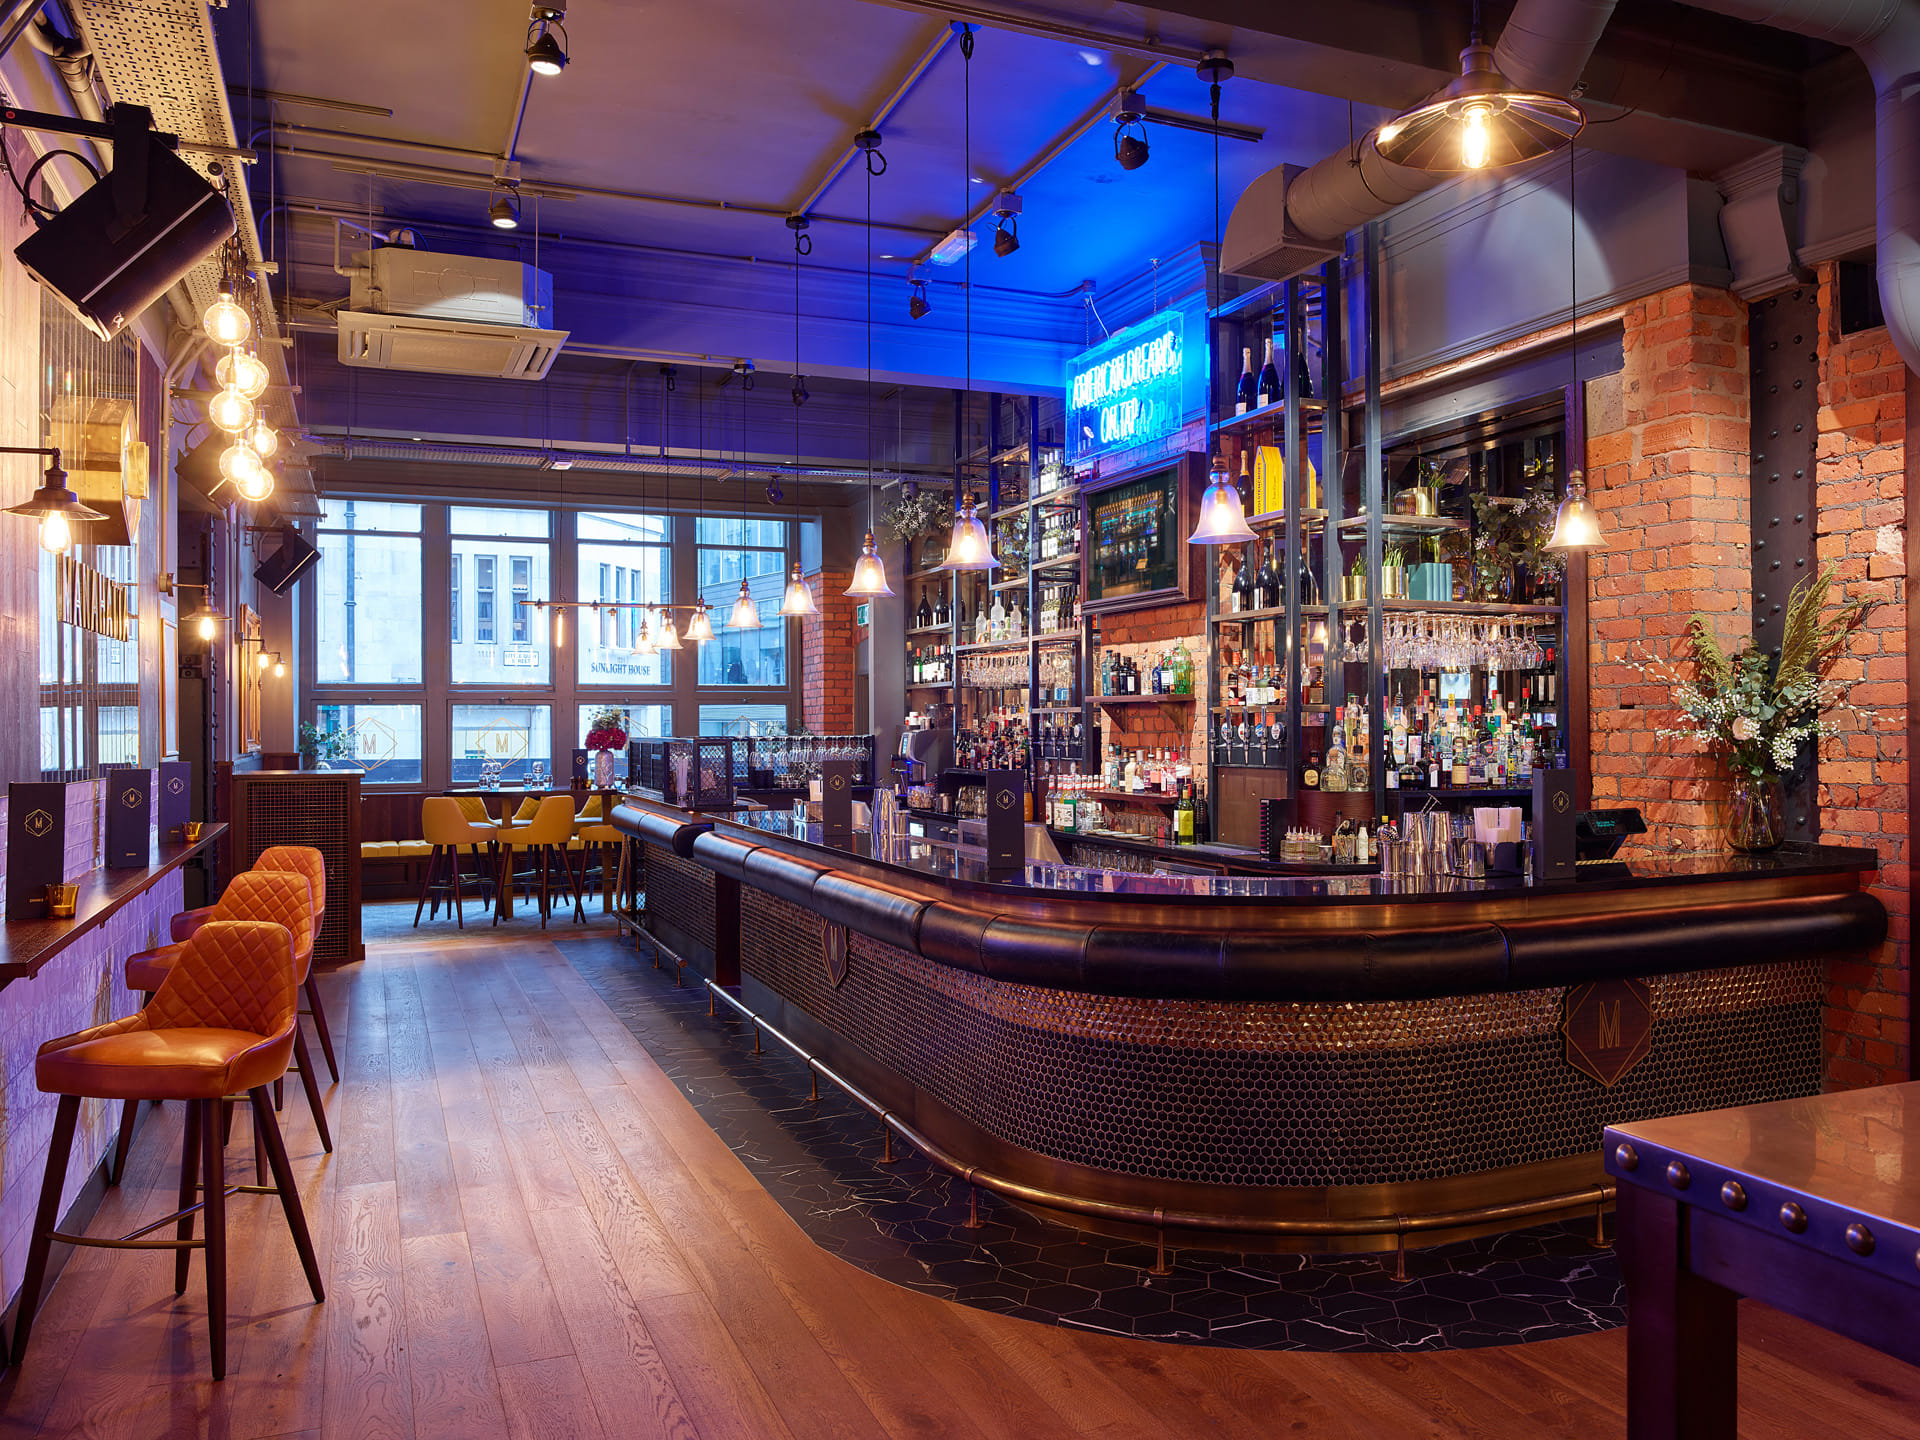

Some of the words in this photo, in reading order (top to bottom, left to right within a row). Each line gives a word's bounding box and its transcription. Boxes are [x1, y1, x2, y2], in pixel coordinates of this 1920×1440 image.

[591, 662, 627, 675] SUNLIGHT
[628, 664, 651, 676] HOUSE
[362, 733, 377, 754] M
[495, 733, 509, 753] M
[1599, 1000, 1620, 1049] M
